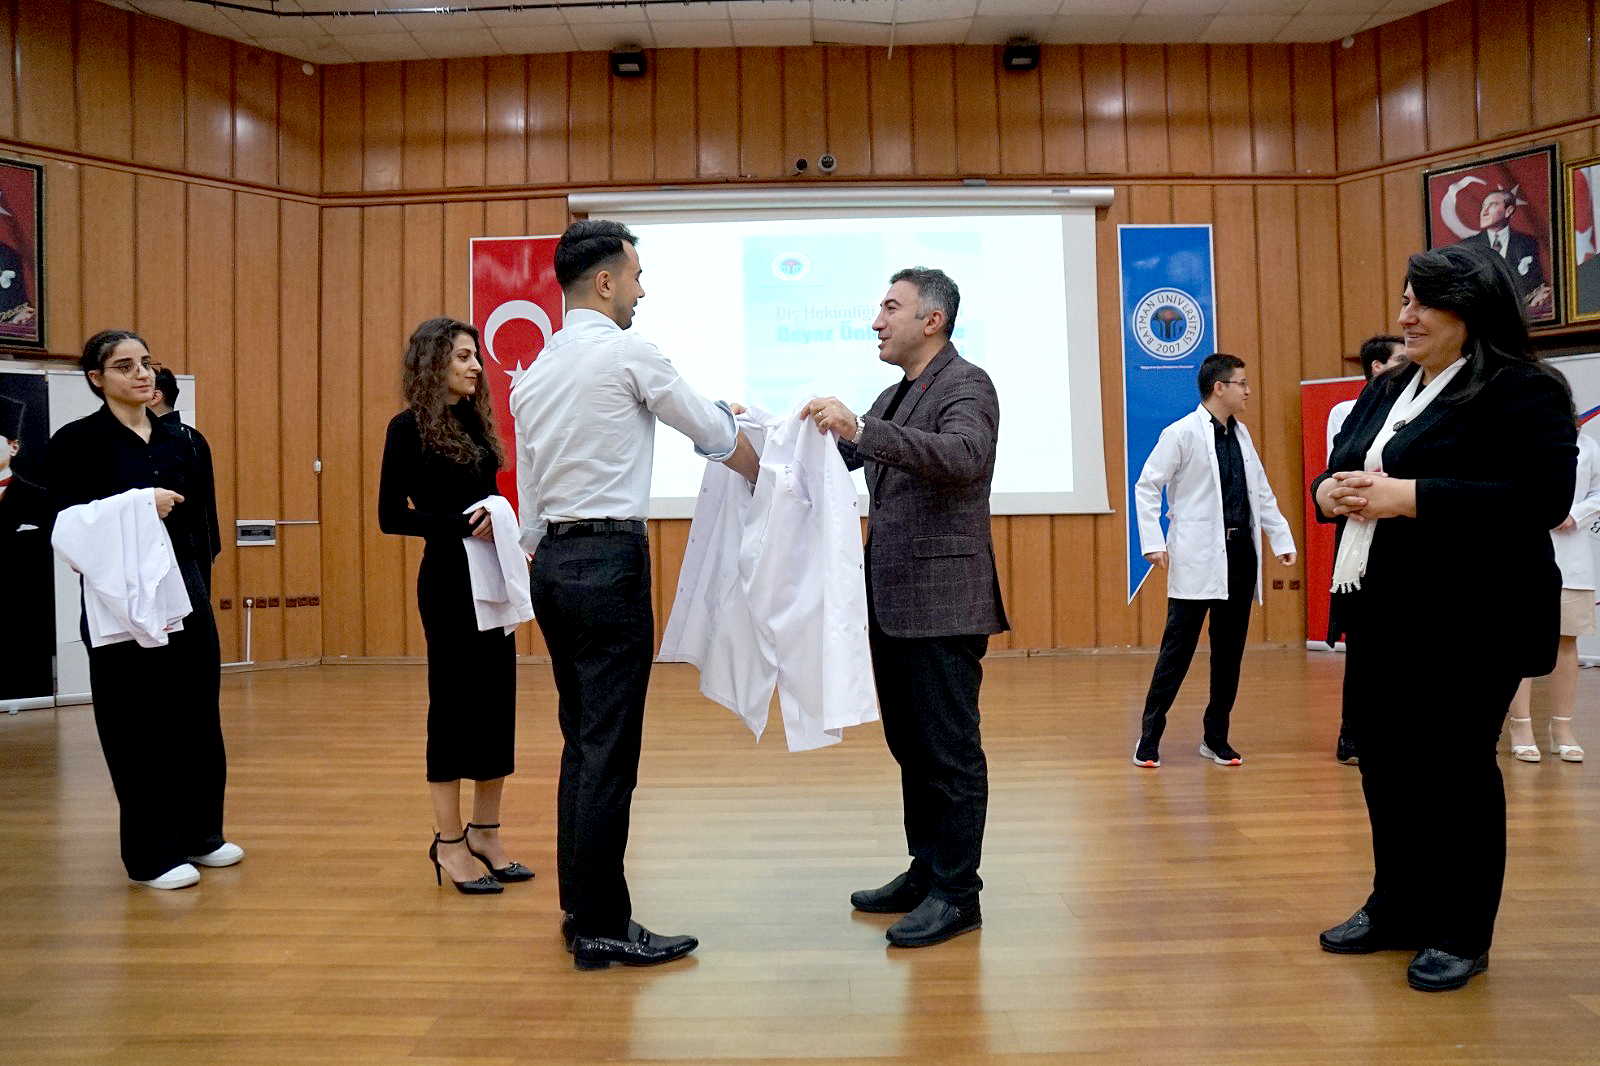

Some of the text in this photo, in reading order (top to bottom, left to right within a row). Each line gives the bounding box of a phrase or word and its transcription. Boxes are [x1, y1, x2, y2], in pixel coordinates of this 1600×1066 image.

[776, 304, 875, 324] Diş Hekimliği
[1138, 300, 1155, 345] BATMAN
[776, 325, 834, 345] Beyaz
[1155, 342, 1180, 354] 2007
